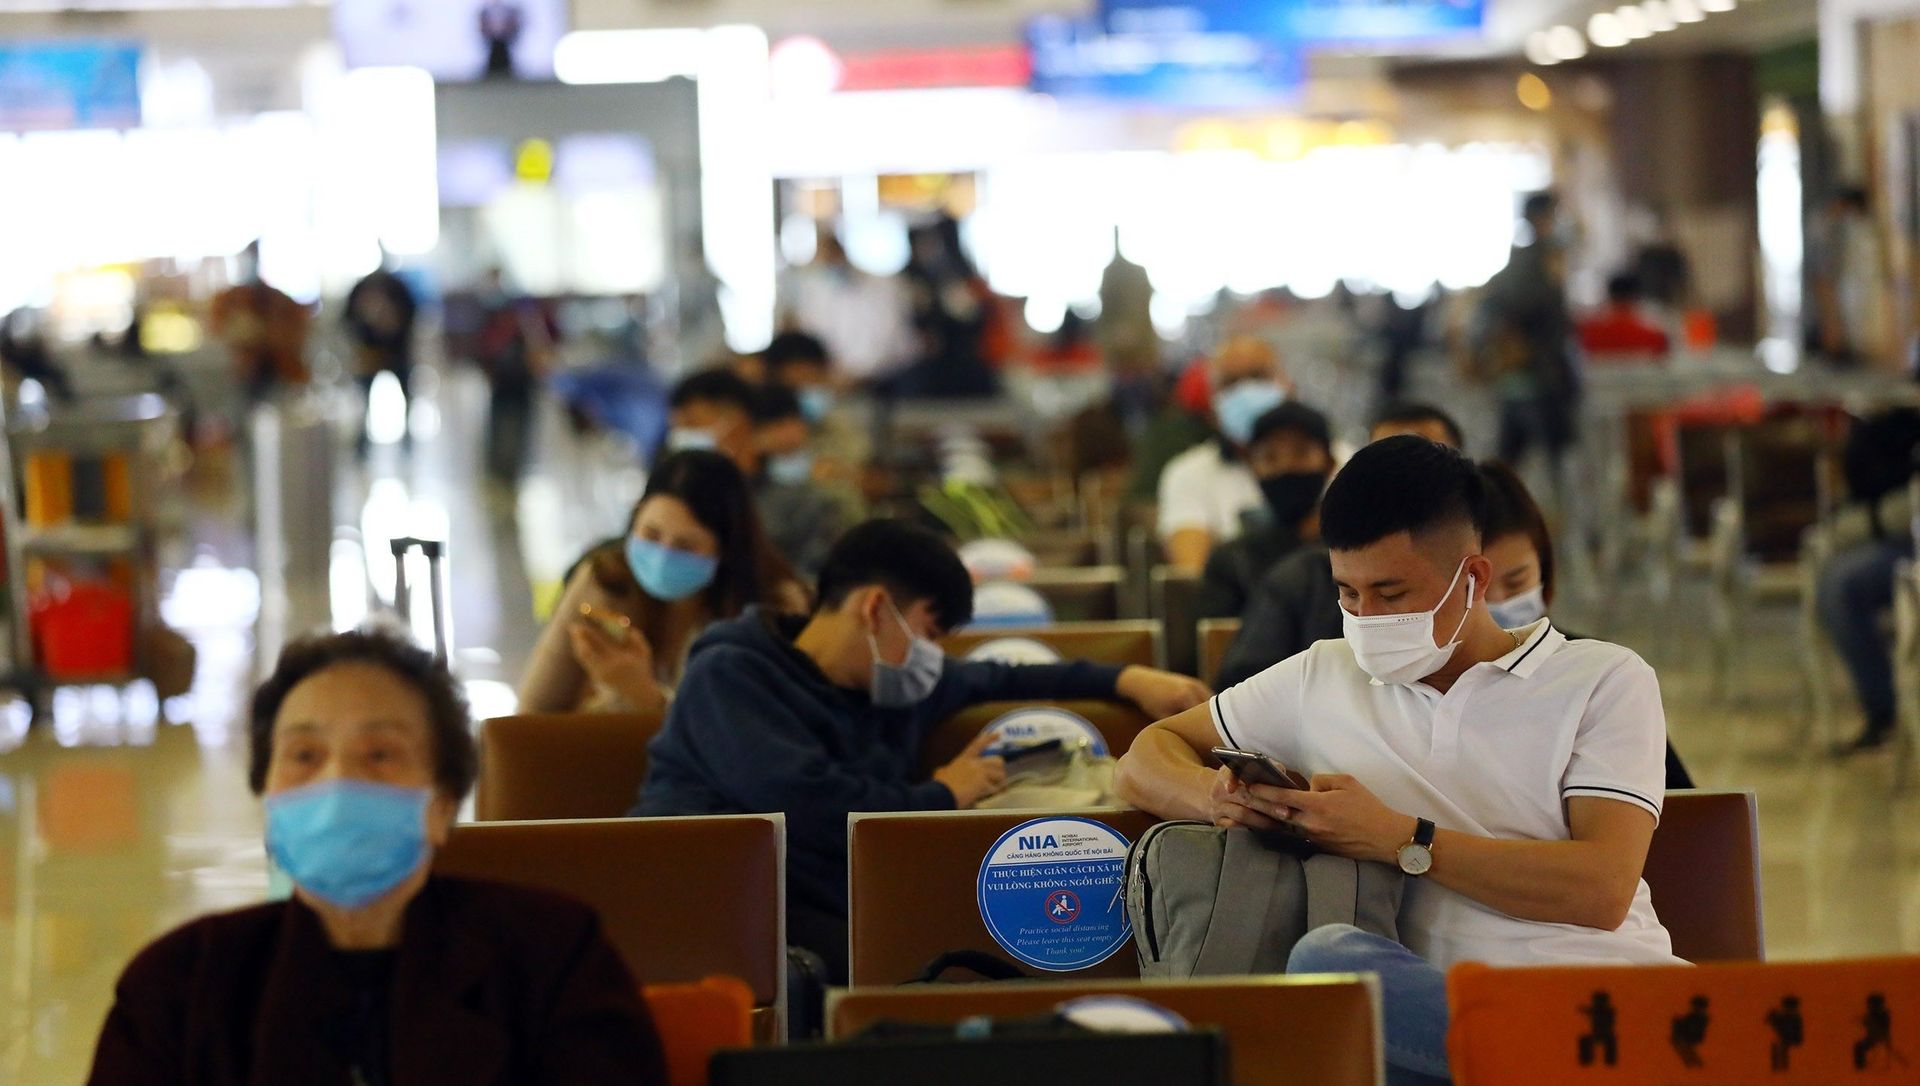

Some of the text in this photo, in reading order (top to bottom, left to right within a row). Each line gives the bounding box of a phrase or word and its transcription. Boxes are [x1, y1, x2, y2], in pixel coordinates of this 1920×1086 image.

[1019, 835, 1058, 850] NIA
[992, 869, 1018, 878] THỰC
[1020, 867, 1043, 877] HIỆN
[1069, 864, 1095, 874] CÁCH
[1097, 863, 1110, 872] XÃ
[1005, 880, 1032, 890] LÒNG
[1033, 879, 1067, 889] KHÔNG
[1094, 873, 1115, 885] GHẾ
[1019, 923, 1110, 935] Practice social distancing
[1016, 938, 1039, 946] Please
[1045, 946, 1068, 955] Thank
